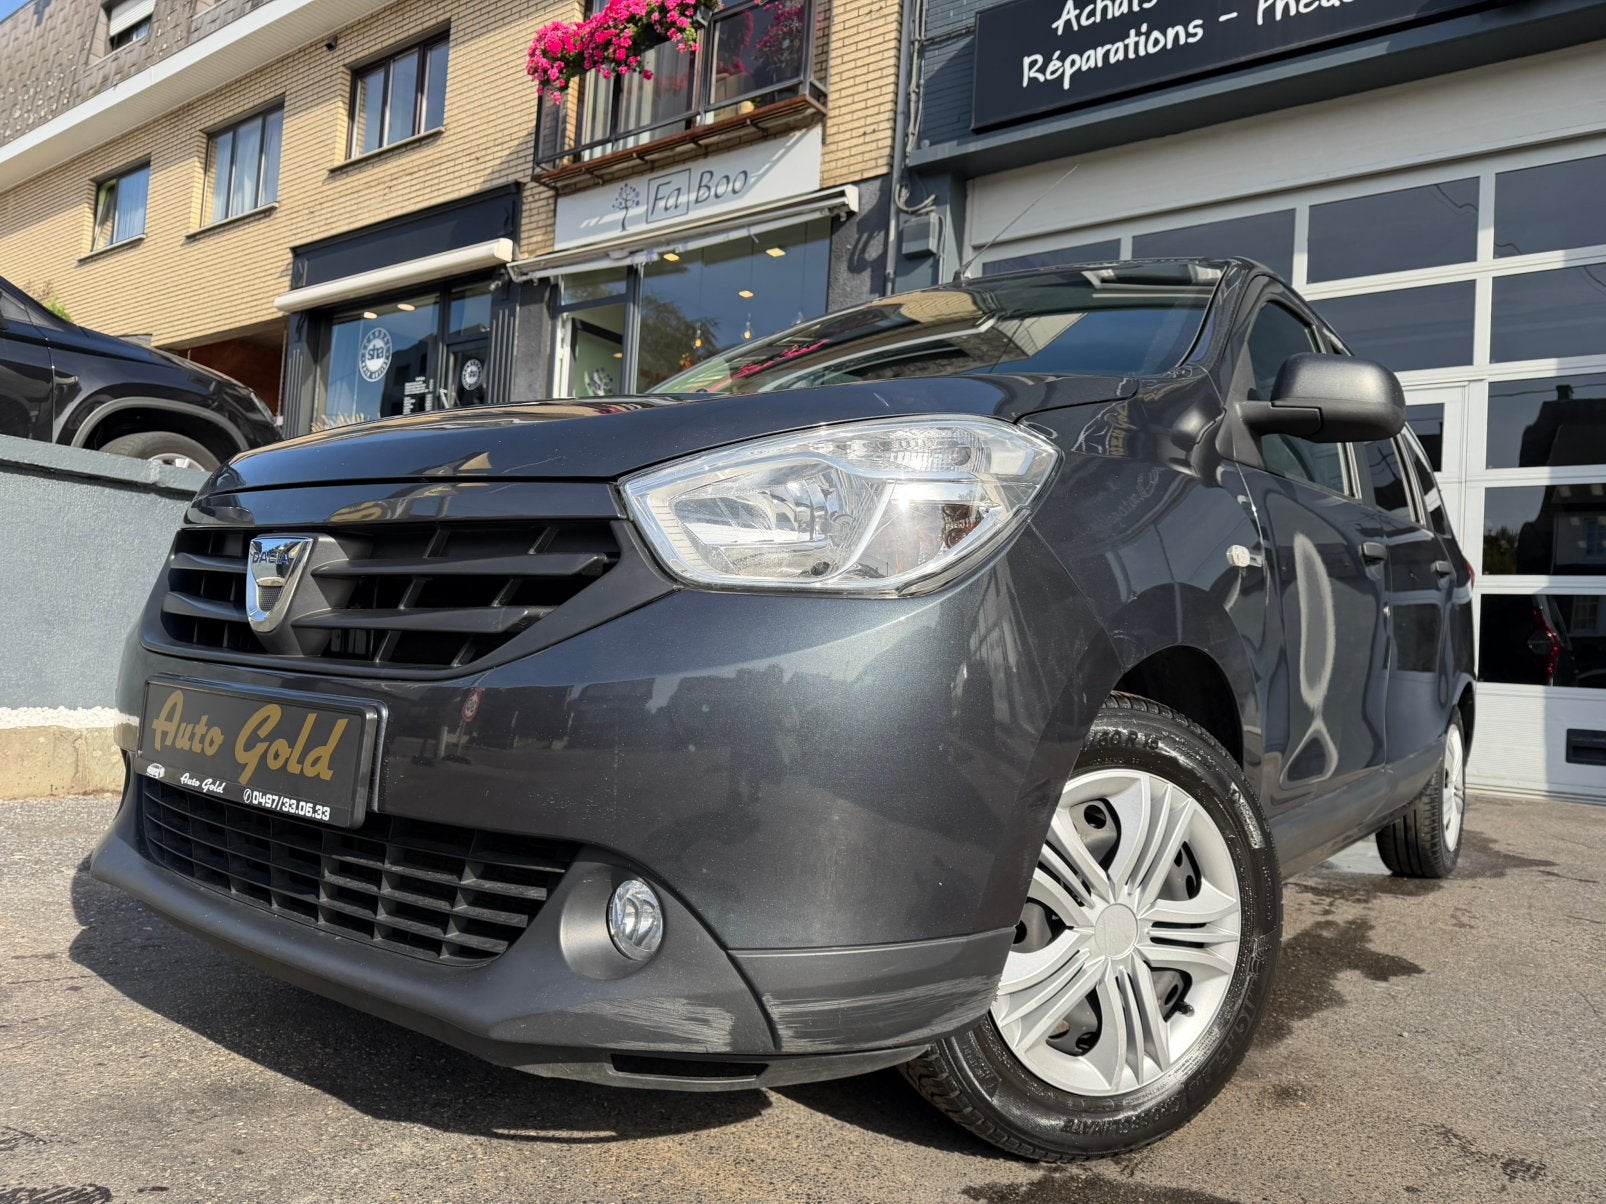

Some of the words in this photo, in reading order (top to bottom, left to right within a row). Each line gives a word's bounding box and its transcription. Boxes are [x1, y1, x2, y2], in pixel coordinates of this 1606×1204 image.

[1022, 19, 1204, 91] Réparations
[649, 180, 682, 217] Fa
[694, 169, 749, 205] Boo
[251, 551, 289, 565] DACIA
[151, 689, 225, 757] Auto
[235, 703, 349, 785] Gold
[179, 772, 201, 788] Auto
[201, 778, 227, 795] Gold
[251, 789, 331, 821] 0497/33.06.33
